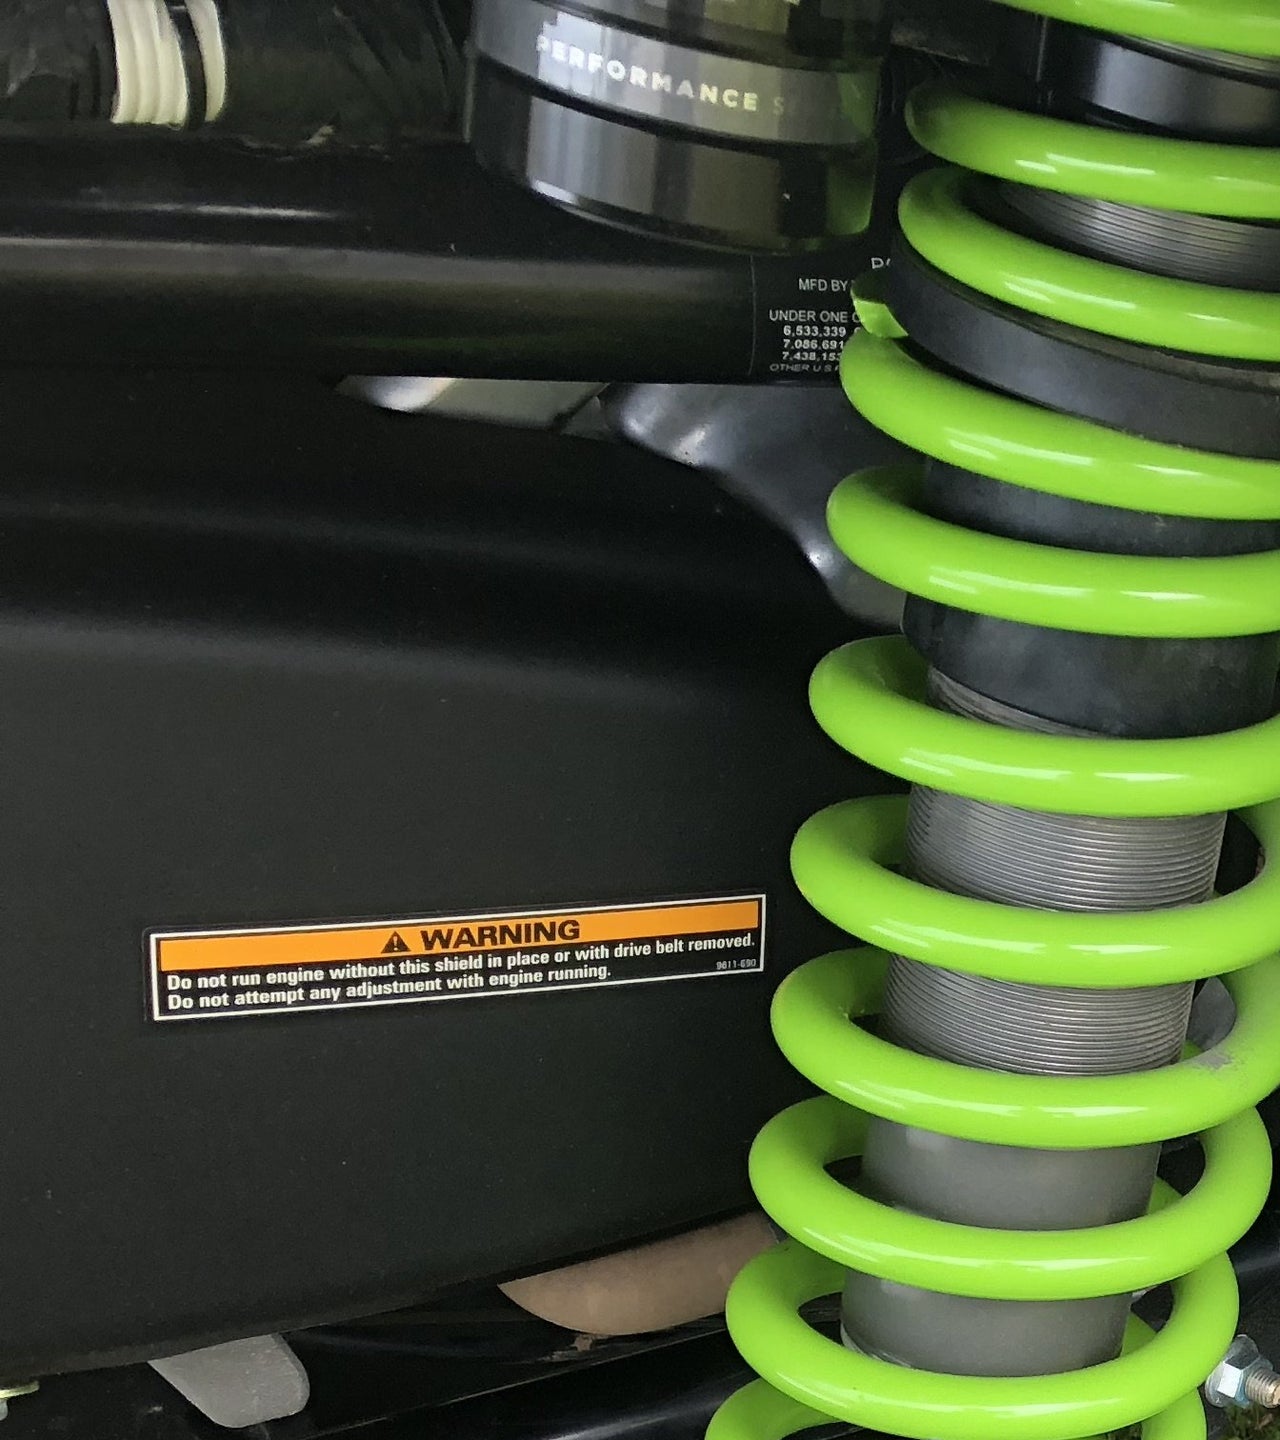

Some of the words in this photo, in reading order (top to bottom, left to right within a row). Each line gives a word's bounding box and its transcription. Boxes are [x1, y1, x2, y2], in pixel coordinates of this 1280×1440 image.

[537, 33, 759, 112] PERFORMANCE
[798, 278, 827, 291] MFD
[831, 280, 848, 292] BY
[769, 309, 816, 322] UNDER
[819, 310, 848, 323] ONE
[769, 363, 810, 372] OTHER
[420, 919, 580, 951] WARNING
[167, 974, 192, 991] Do
[197, 973, 226, 989] not
[231, 972, 261, 986] run
[266, 967, 325, 985] engine
[329, 962, 396, 980] without
[399, 959, 430, 975] this
[434, 954, 483, 973] shield
[487, 953, 503, 968] in
[507, 951, 550, 970] place
[554, 951, 571, 963] or
[575, 945, 610, 961] with
[614, 942, 651, 958] drive
[655, 939, 684, 955] belt
[688, 932, 756, 951] removed.
[168, 994, 193, 1010] Do
[199, 992, 230, 1008] not
[234, 988, 305, 1006] attempt
[309, 987, 342, 1002] any
[346, 977, 442, 999] adjustment
[447, 973, 484, 989] with
[488, 969, 544, 988] engine
[548, 965, 612, 981] running.
